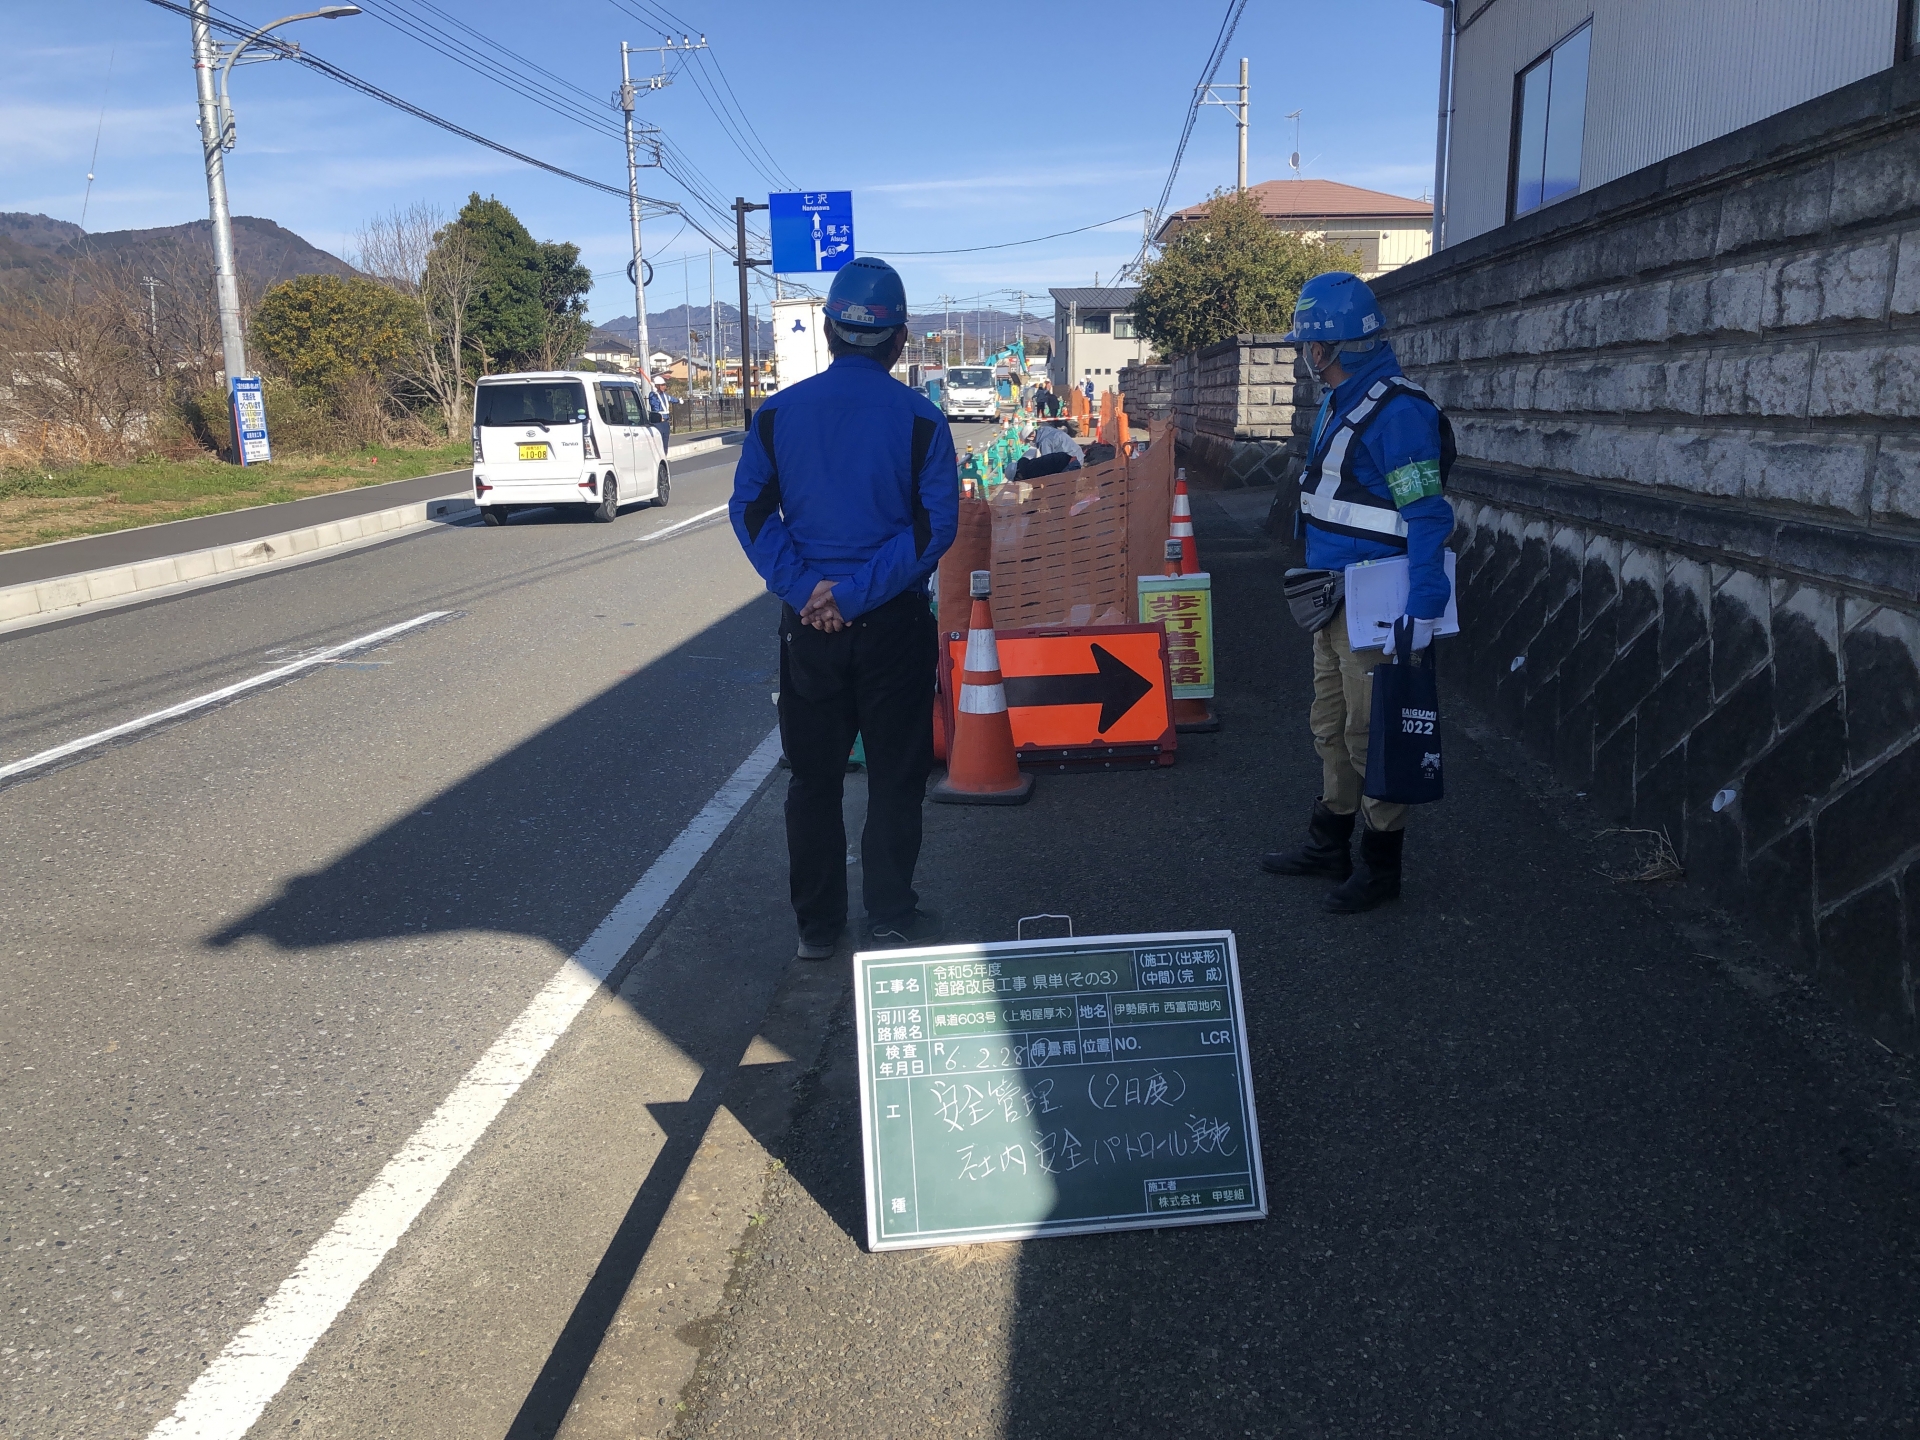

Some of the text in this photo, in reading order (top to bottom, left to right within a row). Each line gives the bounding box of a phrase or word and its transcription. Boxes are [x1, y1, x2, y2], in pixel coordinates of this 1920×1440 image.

[803, 193, 829, 204] 七沢
[826, 224, 850, 235] 厚木
[526, 450, 547, 459] 10-08
[1401, 707, 1437, 720] KAIGUMI
[1401, 719, 1434, 735] 2022
[933, 962, 1002, 980] 令和5年度
[875, 978, 920, 995] 工事名
[935, 976, 1027, 997] 道路改良工事
[1079, 1004, 1107, 1019] 地名
[1114, 999, 1222, 1016] 伊勢原市 西富岡地内
[877, 1008, 922, 1026] 河川名
[877, 1025, 923, 1042] 路線名
[1201, 1031, 1230, 1046] LCR
[934, 1042, 946, 1056] R
[1083, 1038, 1111, 1053] 位置
[1115, 1036, 1142, 1051] NO.
[885, 1044, 918, 1060] 検査
[879, 1059, 924, 1077] 年月日
[930, 1077, 1063, 1132] 安全管理
[886, 1104, 907, 1214] 工 種
[1148, 1181, 1177, 1193] 施工者
[1158, 1188, 1245, 1208] 株式会社 甲斐組
